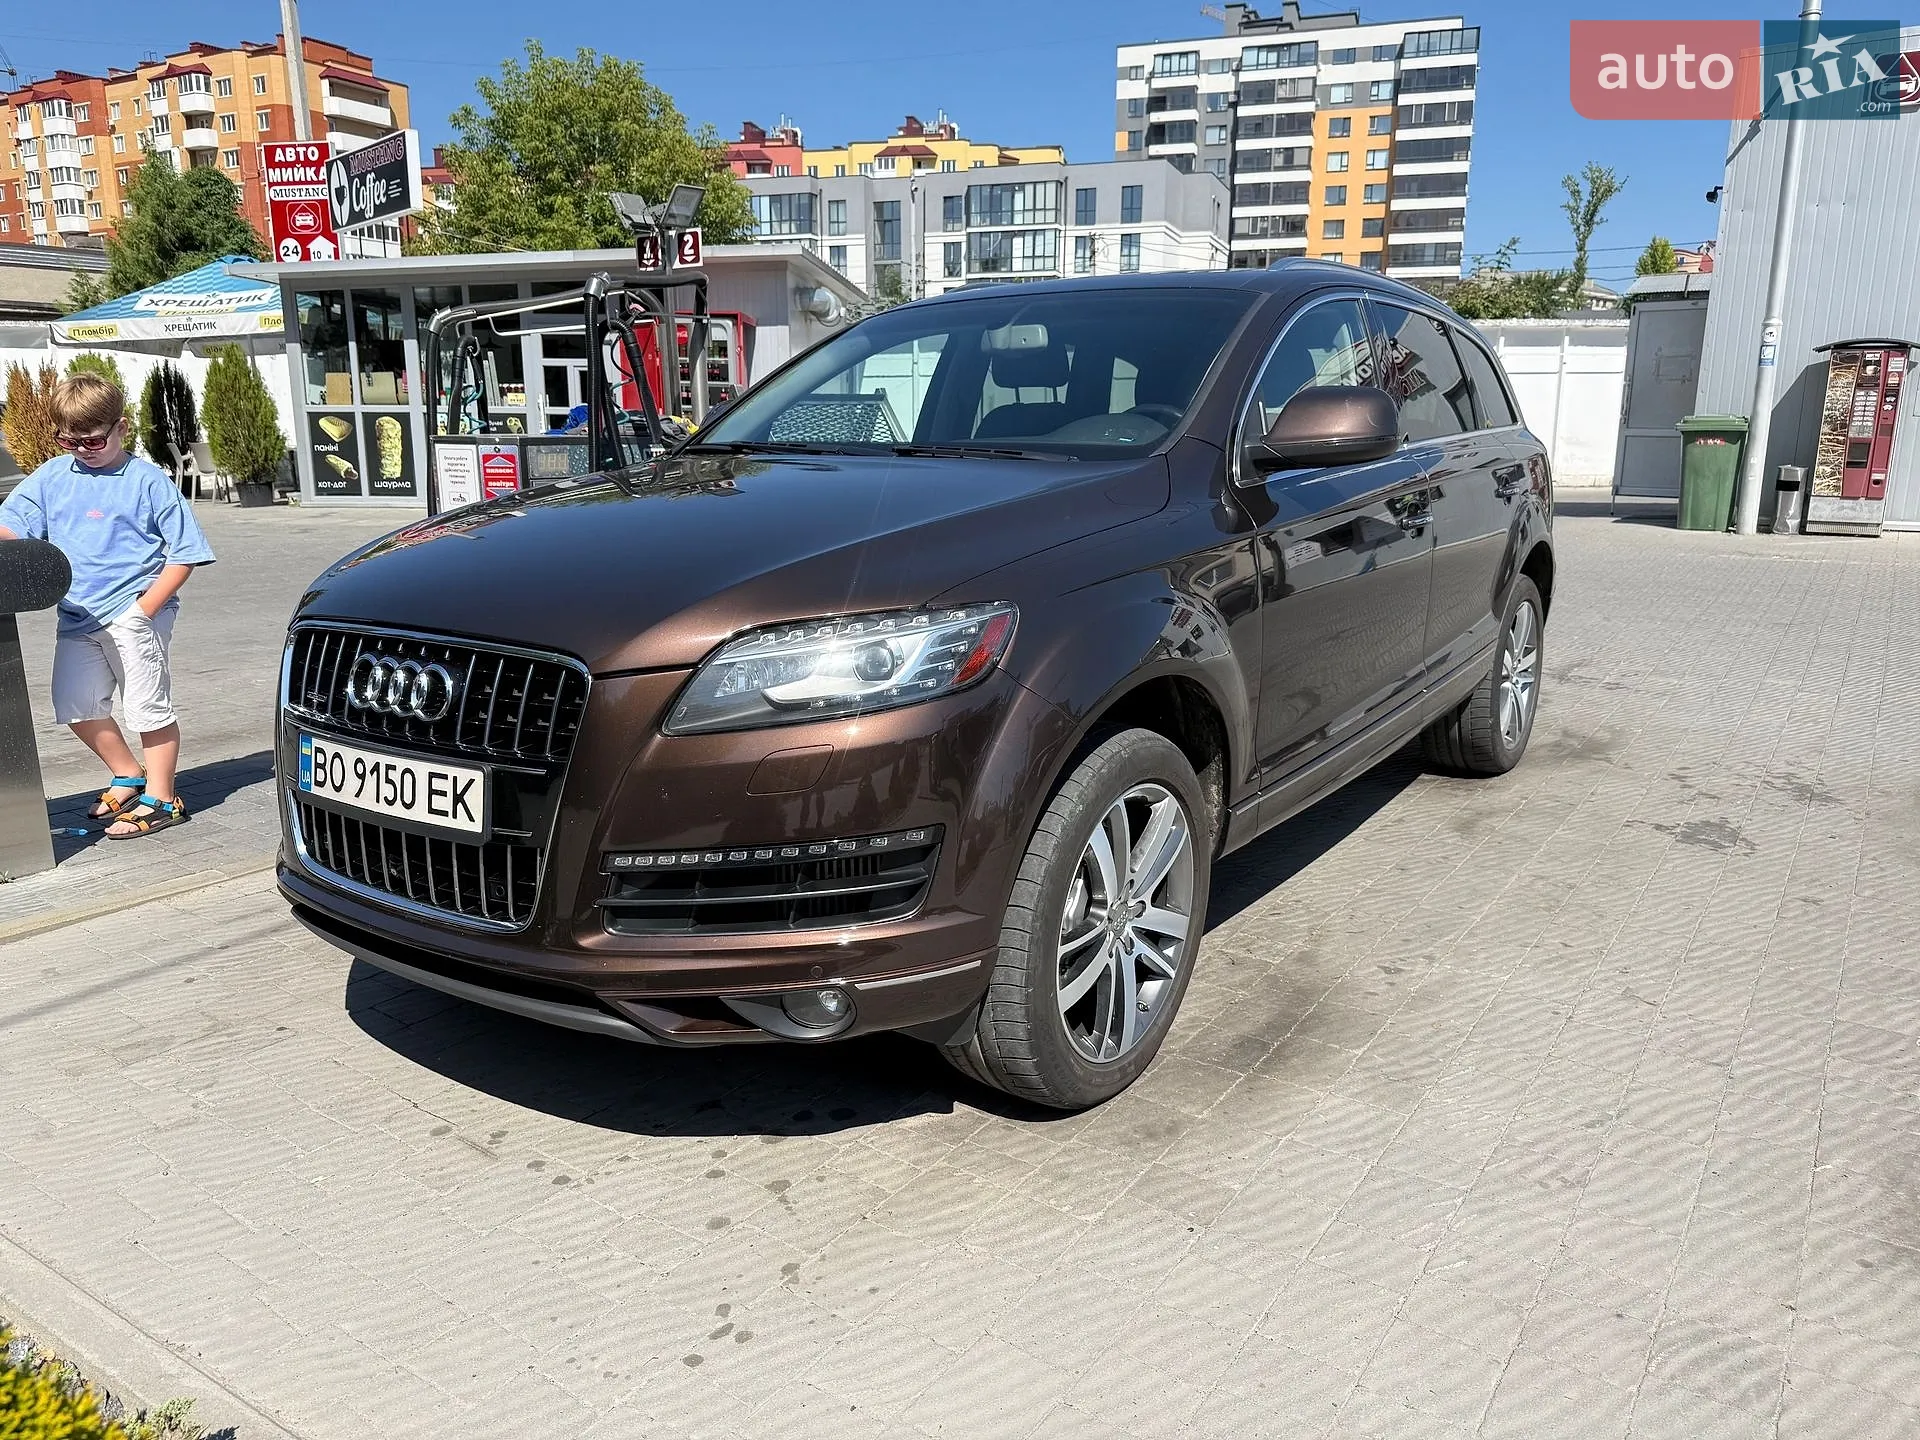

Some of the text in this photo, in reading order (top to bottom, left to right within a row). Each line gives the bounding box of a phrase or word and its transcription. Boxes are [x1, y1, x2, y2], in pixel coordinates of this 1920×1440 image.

[274, 146, 320, 163] АВТО
[349, 137, 404, 176] MUSTANG
[268, 164, 327, 183] МИЙКА
[273, 187, 328, 199] MUSTANG
[352, 172, 387, 219] Coffee
[282, 245, 300, 257] 24
[683, 234, 694, 255] 2
[312, 250, 322, 260] 10
[144, 292, 267, 308] ХРЕЩАТИК
[72, 326, 114, 337] Пломбір
[164, 320, 217, 332] ХРЕЩАТИК
[314, 443, 339, 452] паніні
[374, 481, 411, 489] шаурма
[301, 769, 311, 785] UA
[314, 746, 476, 823] BO 9150 EK
